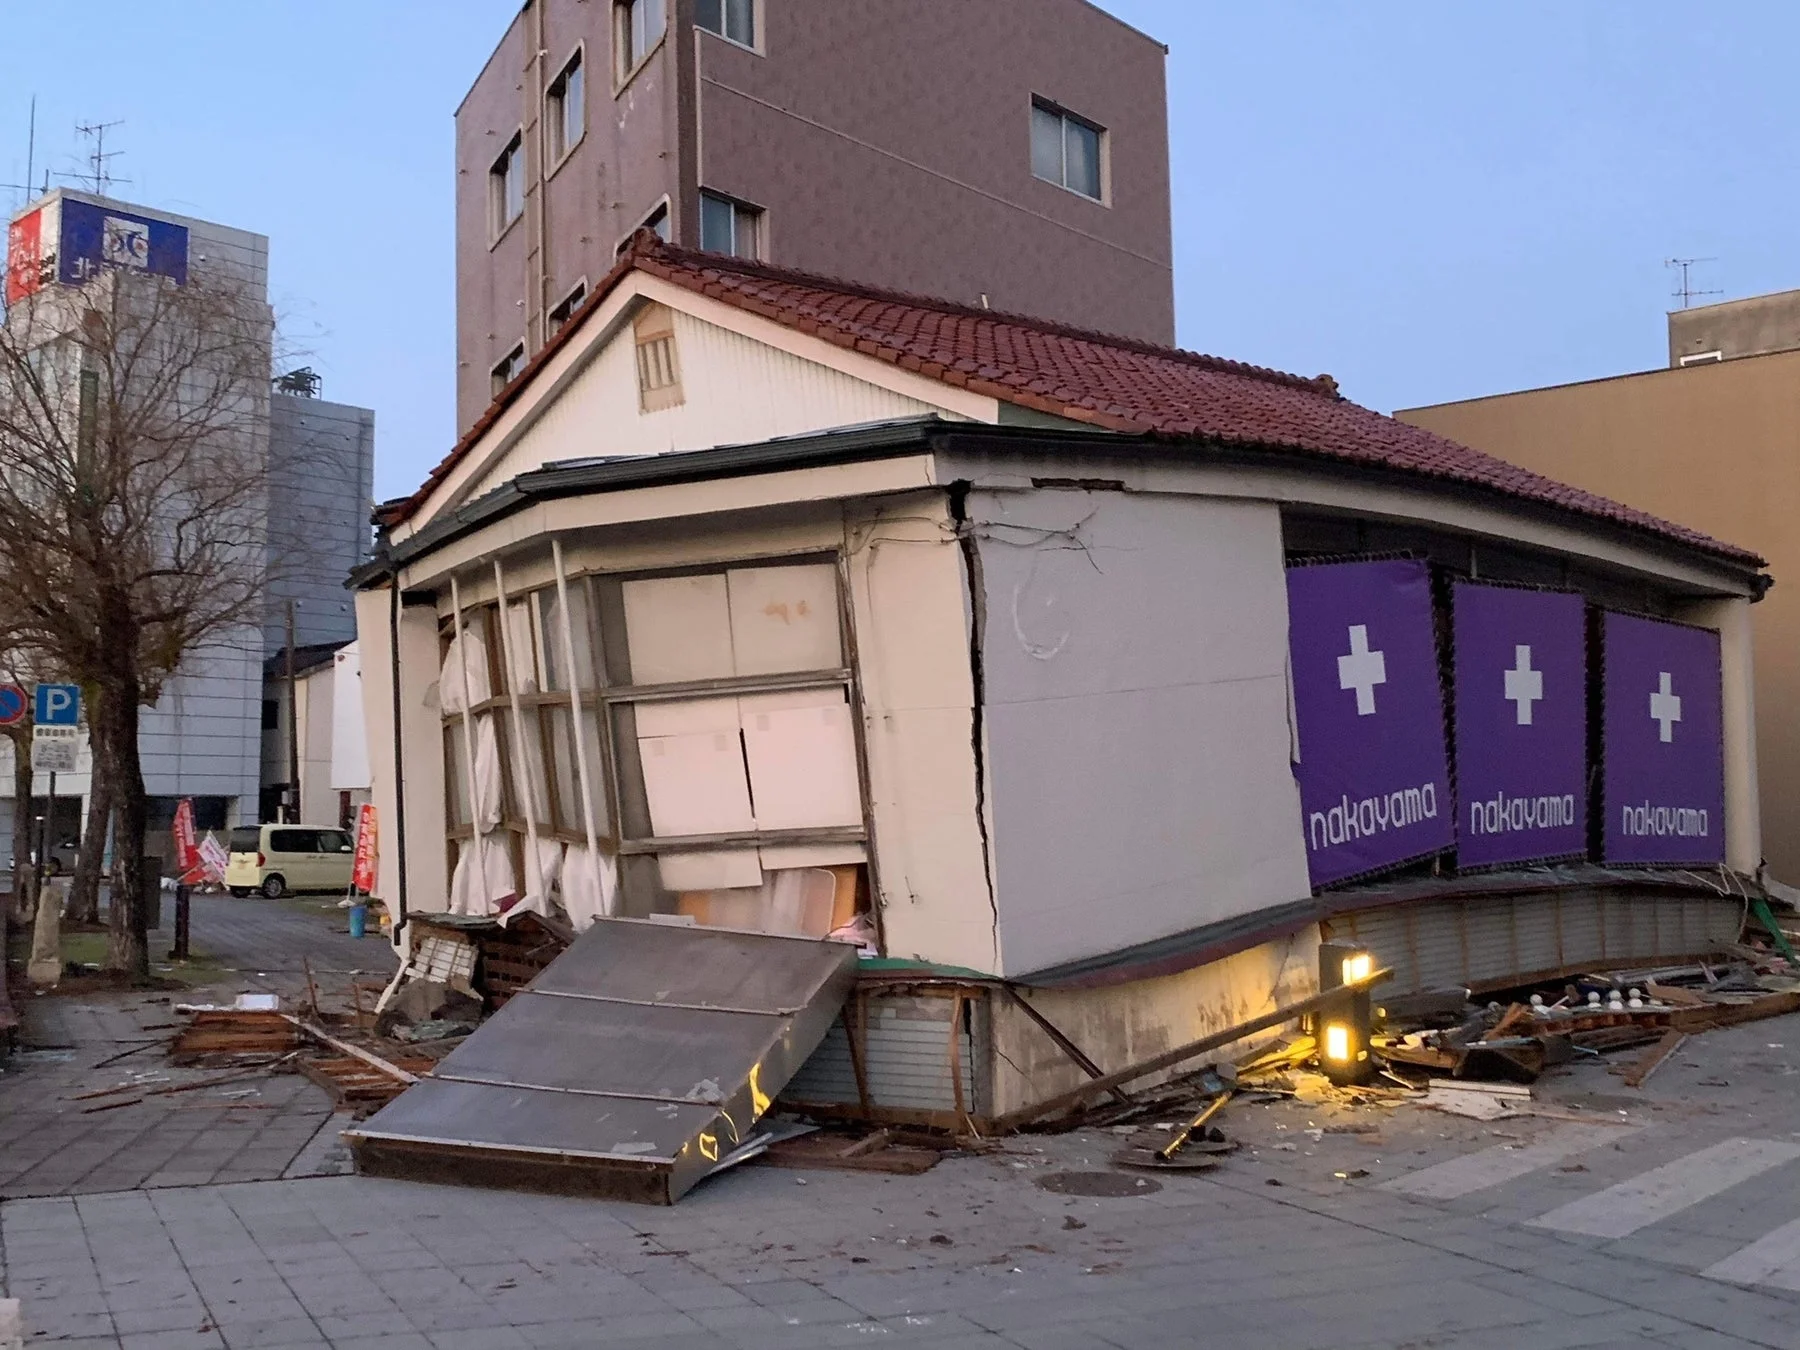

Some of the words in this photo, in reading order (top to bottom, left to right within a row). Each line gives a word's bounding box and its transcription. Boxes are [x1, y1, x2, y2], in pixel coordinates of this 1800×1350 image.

[47, 689, 71, 720] P
[1310, 782, 1438, 851] nakayama
[1471, 791, 1574, 835] nakayama
[1622, 800, 1708, 837] nakayama
